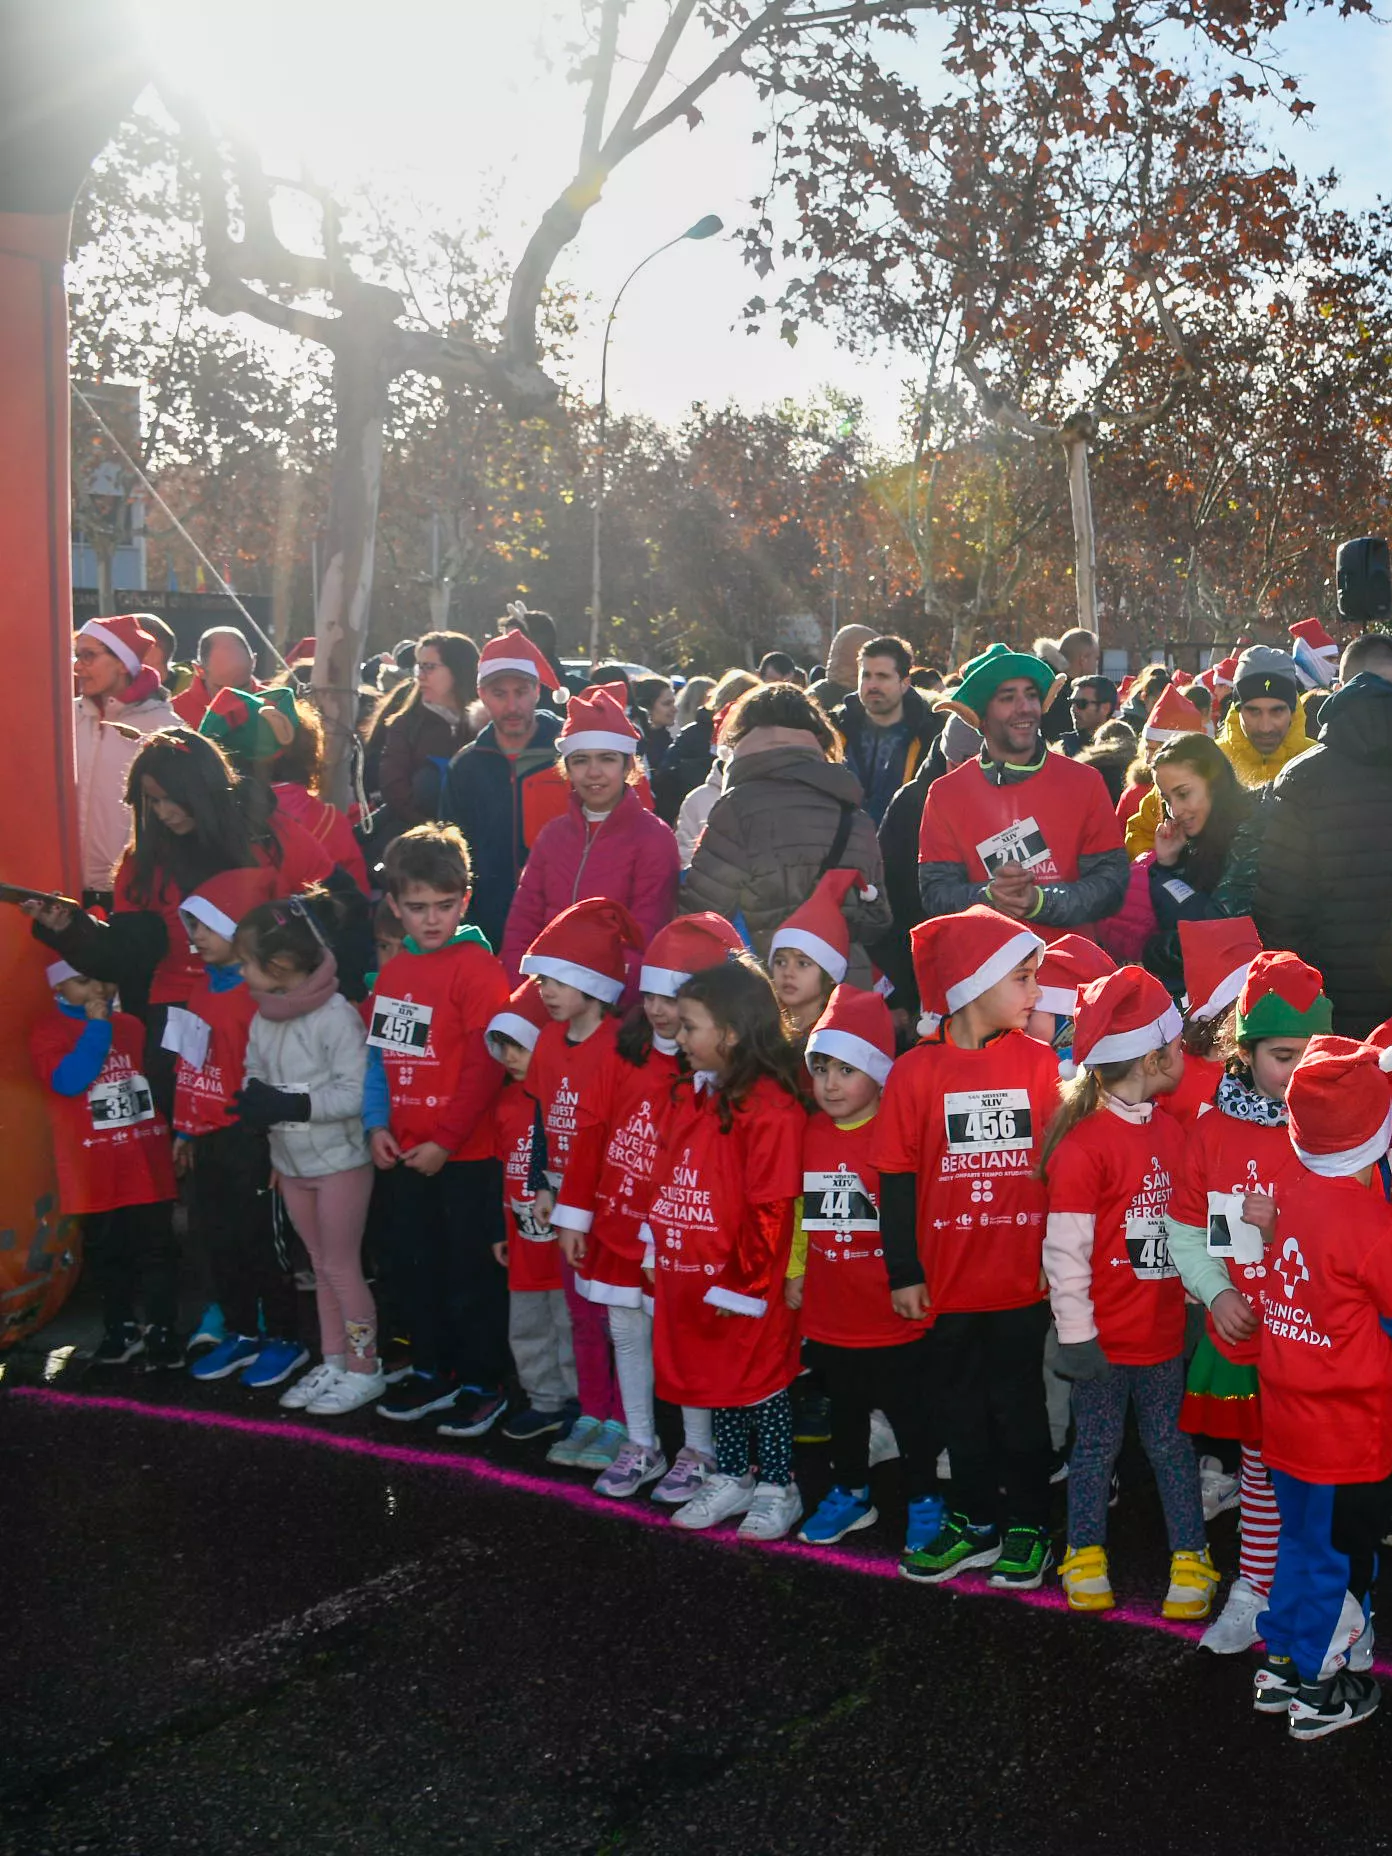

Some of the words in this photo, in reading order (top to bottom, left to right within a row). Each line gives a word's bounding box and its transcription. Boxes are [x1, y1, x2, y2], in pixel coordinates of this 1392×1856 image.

[1001, 832, 1017, 844] XLIV
[381, 1016, 415, 1044] 451
[981, 1098, 1003, 1107] XLIV
[625, 1115, 659, 1142] SAN
[965, 1110, 1016, 1141] 456
[941, 1151, 1029, 1173] BERCIANA
[1143, 1171, 1171, 1191] SAN
[820, 1191, 851, 1218] 44
